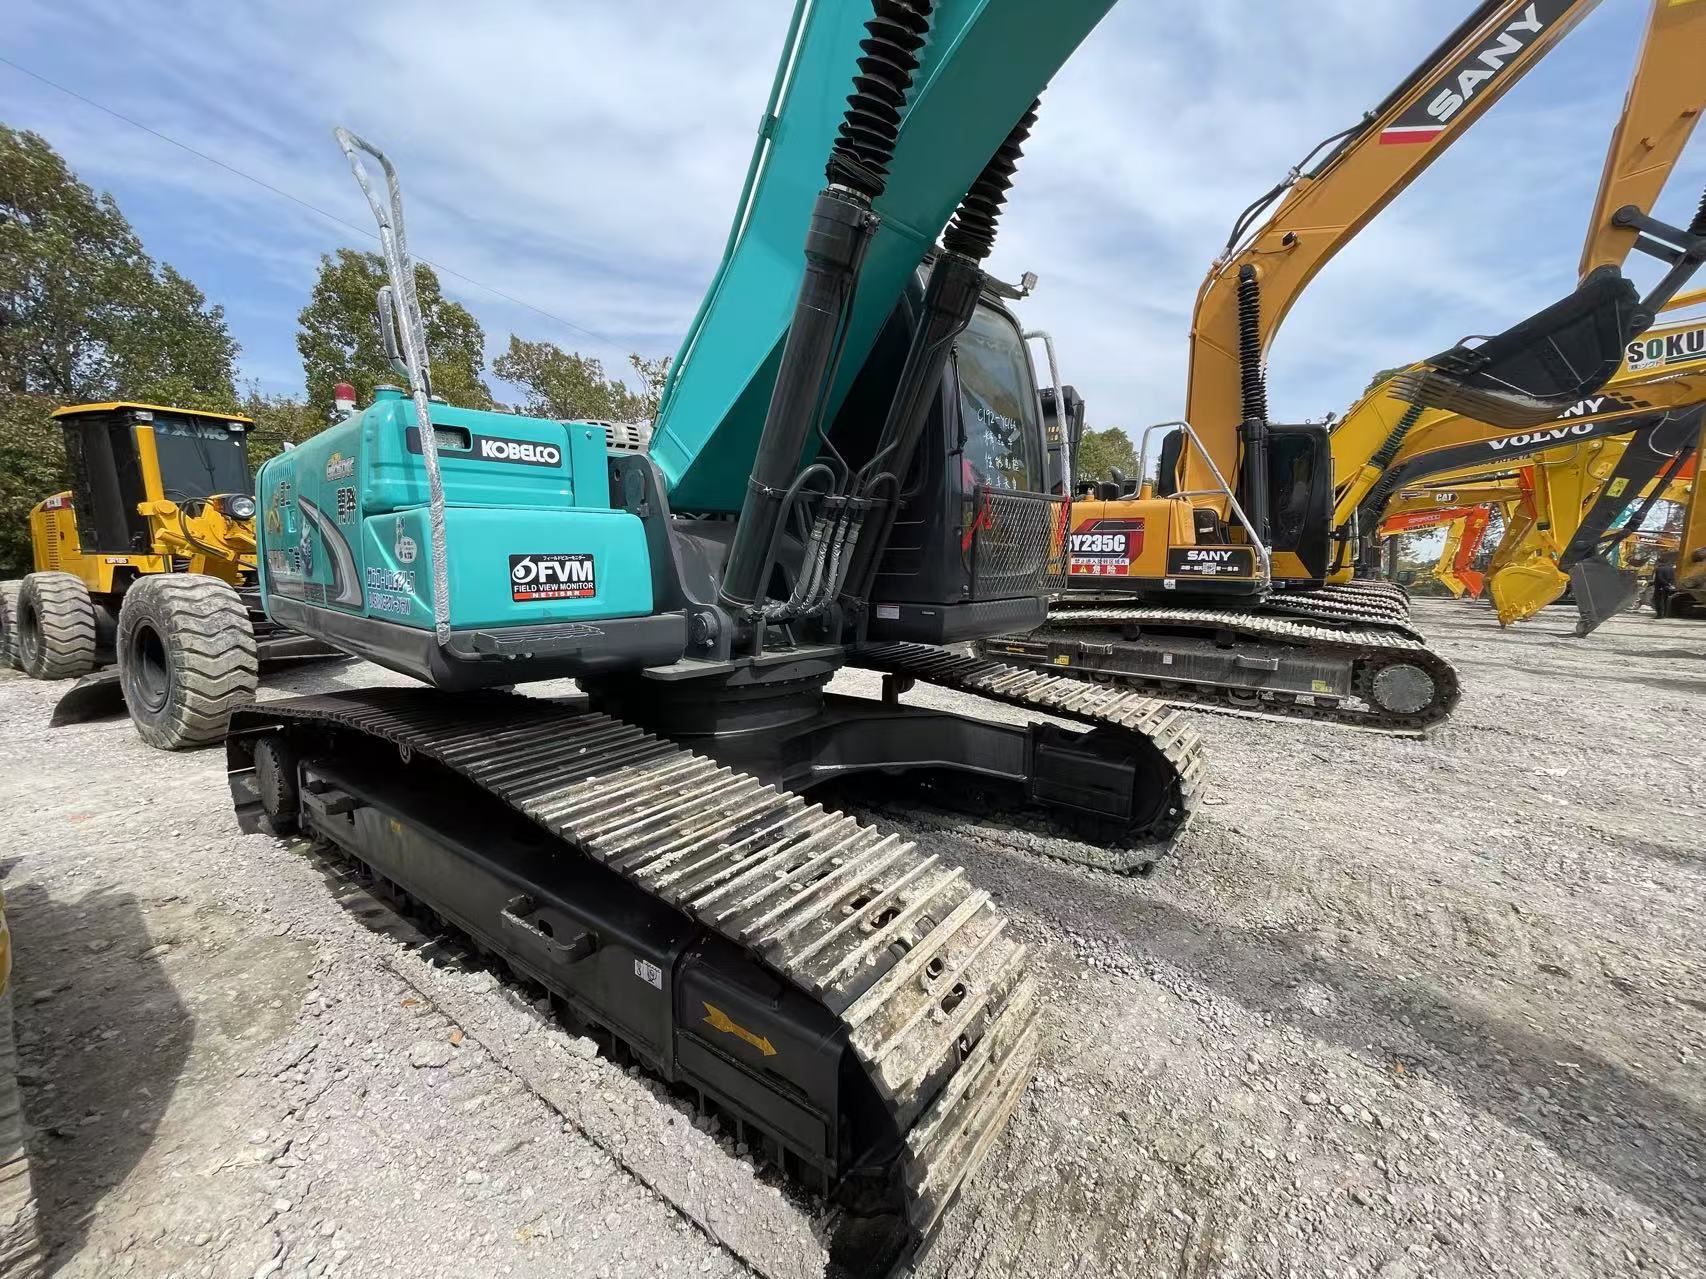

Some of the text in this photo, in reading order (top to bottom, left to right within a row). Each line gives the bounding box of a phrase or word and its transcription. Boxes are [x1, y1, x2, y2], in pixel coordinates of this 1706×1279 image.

[1427, 2, 1543, 122] SANY
[1557, 397, 1604, 418] NY
[1488, 423, 1594, 451] VOLVO
[481, 440, 560, 464] KOBELCO
[1436, 493, 1453, 502] CAT
[1187, 550, 1233, 561] SANY
[538, 560, 594, 583] FVM
[514, 582, 594, 593] FIELD VIEW MONITOR
